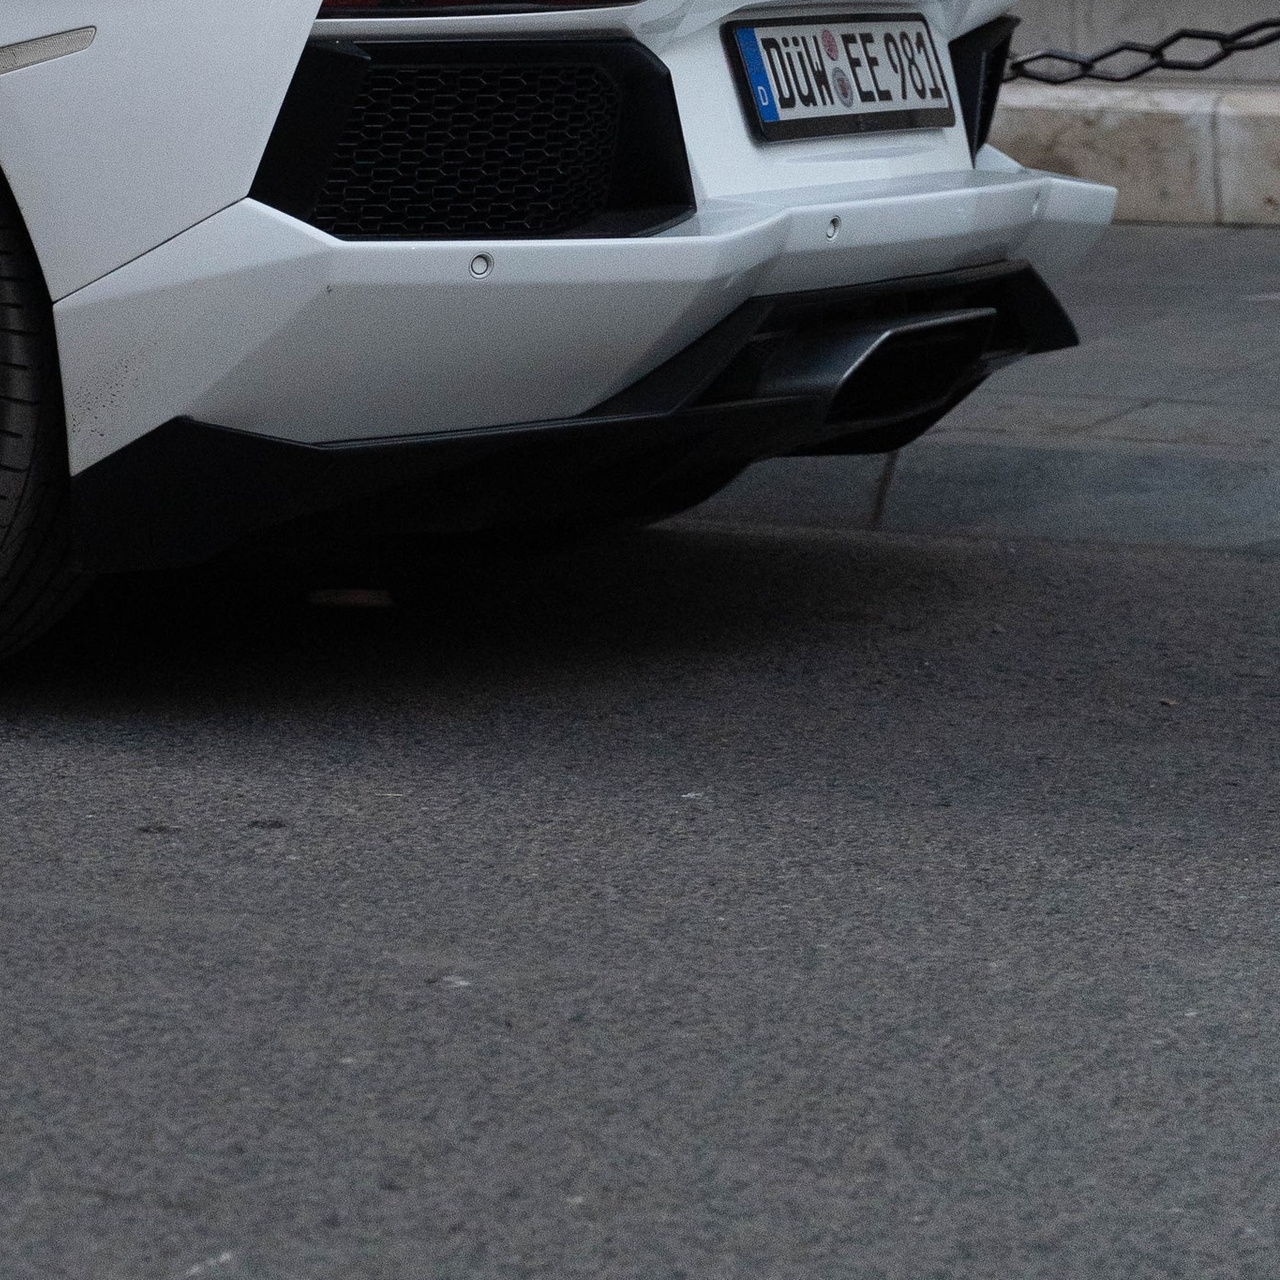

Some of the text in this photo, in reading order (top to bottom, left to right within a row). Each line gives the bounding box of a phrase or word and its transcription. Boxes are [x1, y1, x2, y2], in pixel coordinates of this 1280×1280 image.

[756, 31, 943, 110] D DÜW EE 981
